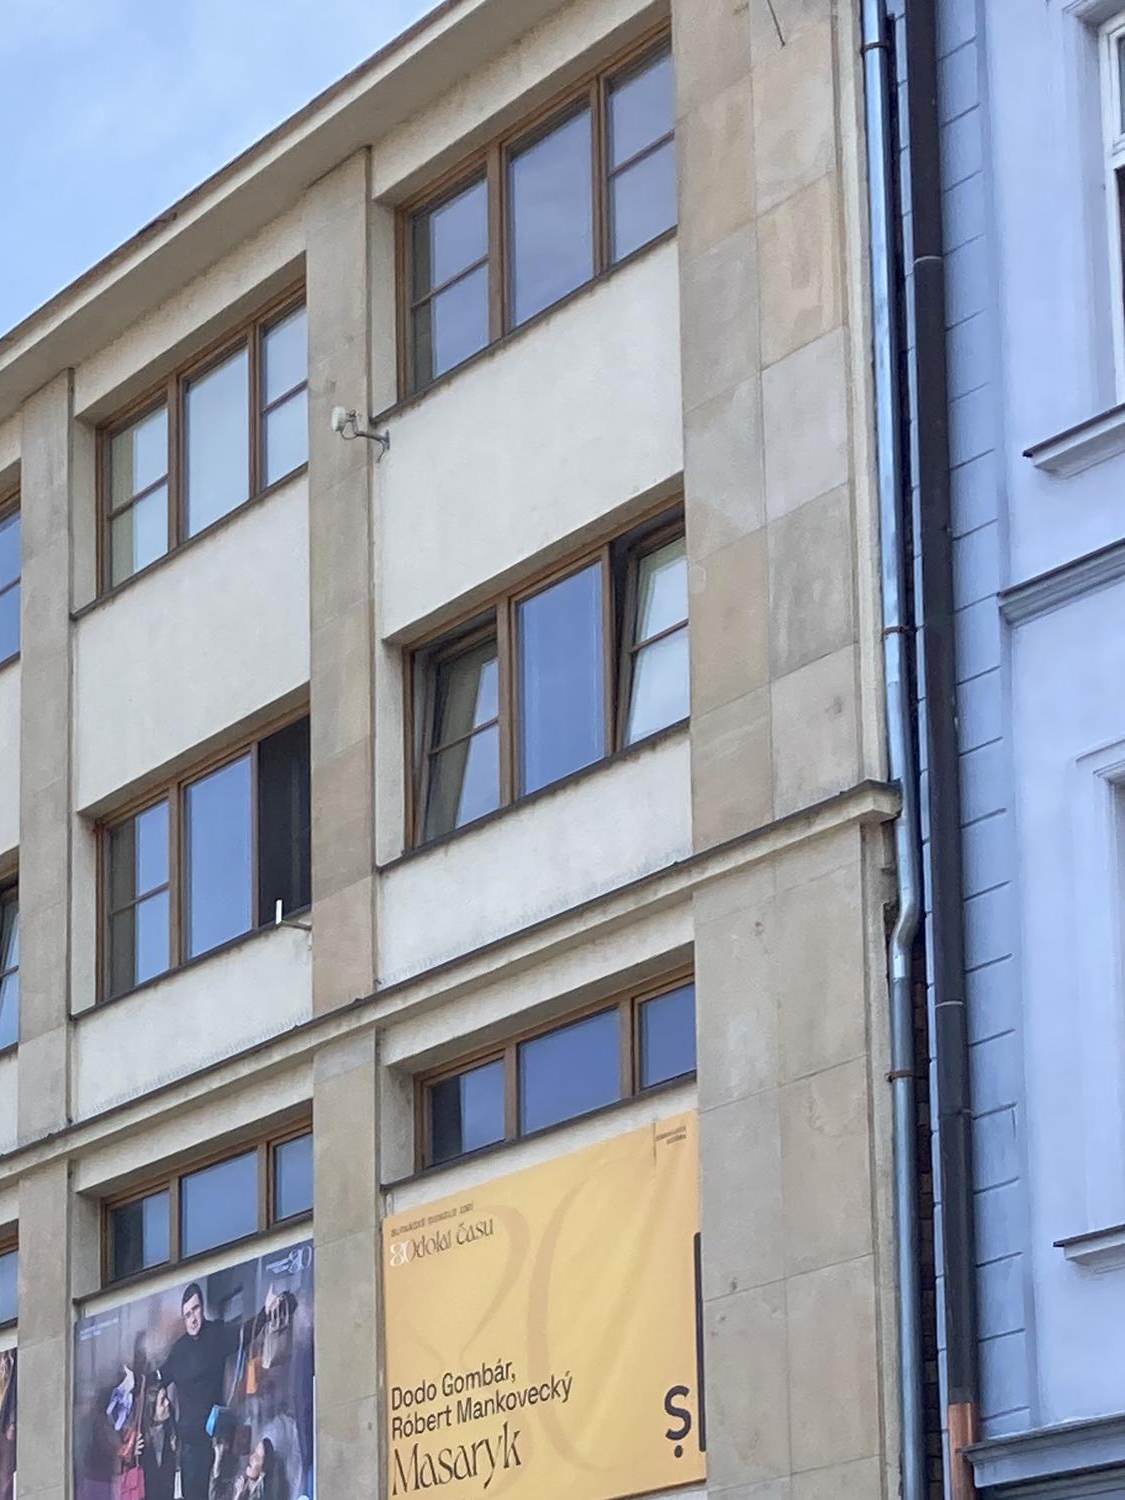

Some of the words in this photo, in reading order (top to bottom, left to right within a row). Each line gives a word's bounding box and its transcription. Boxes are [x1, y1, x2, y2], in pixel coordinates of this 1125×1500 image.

[391, 1380, 437, 1411] Dodo
[442, 1358, 516, 1398] Gombár,
[391, 1404, 453, 1441] Róbert
[456, 1370, 573, 1425] Mankovecký
[392, 1421, 522, 1496] Masaryk
